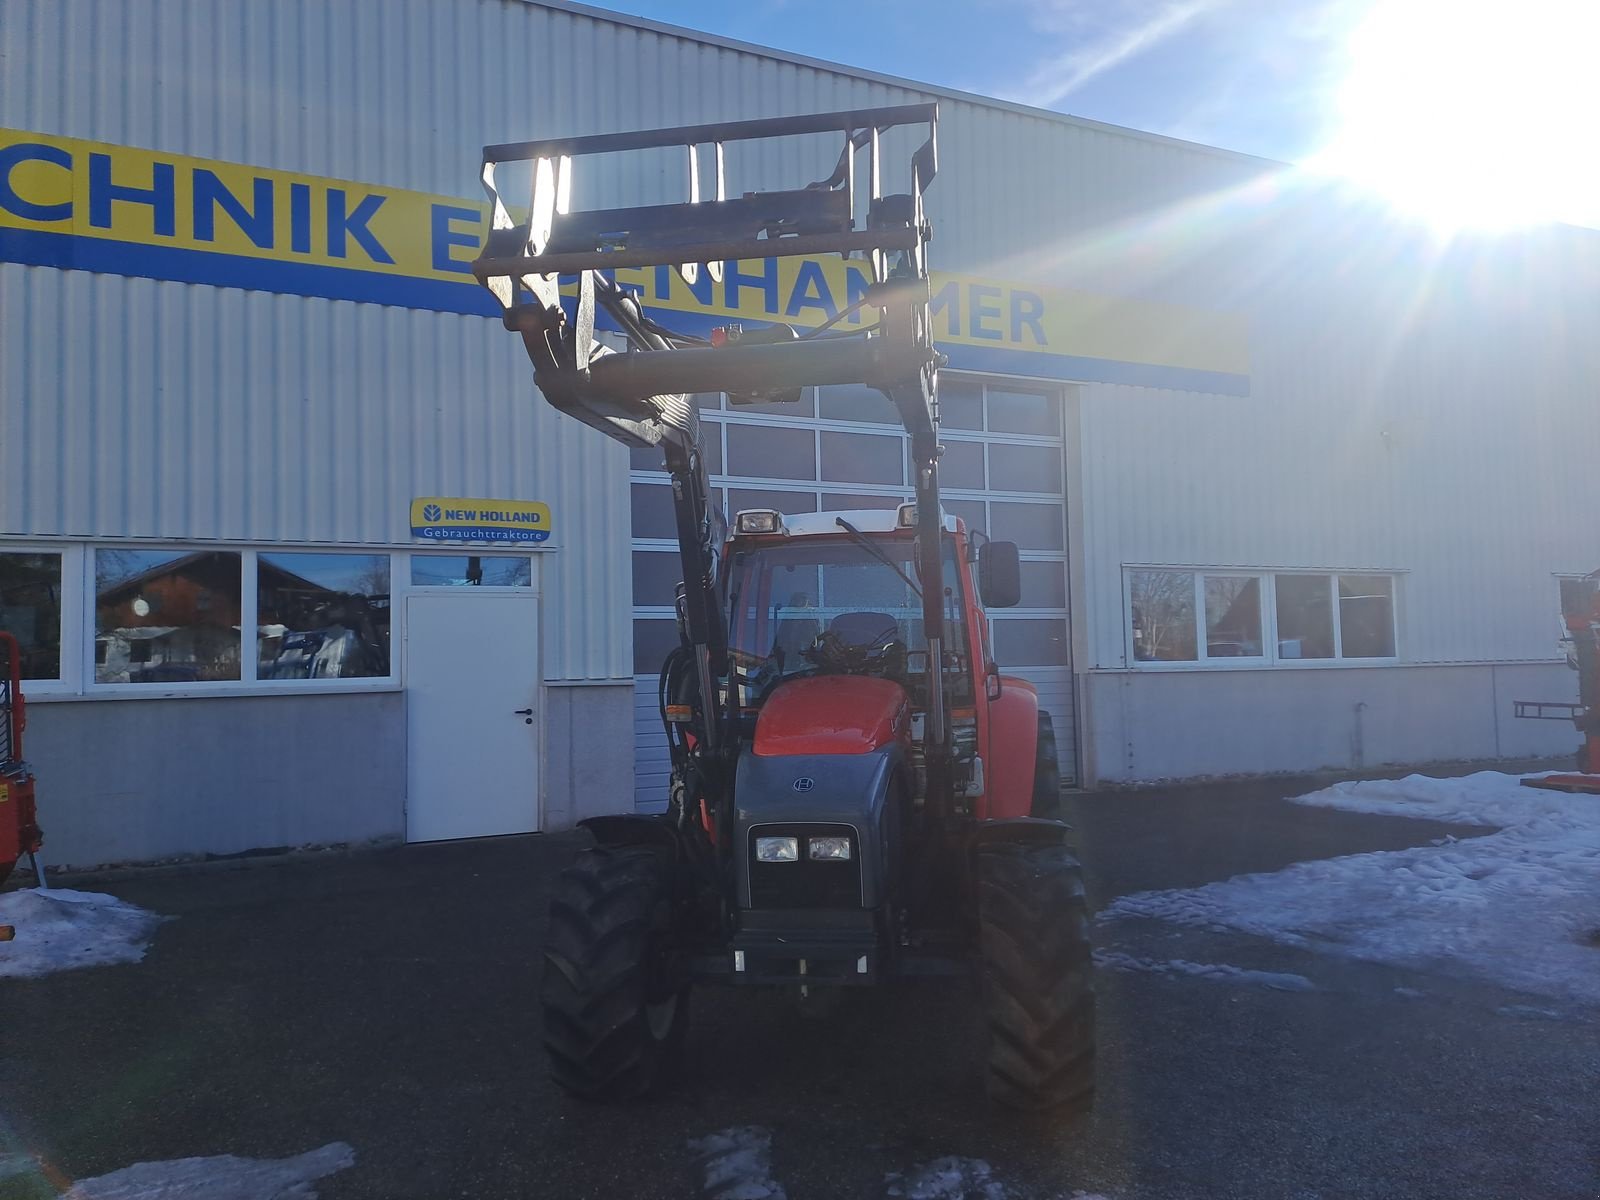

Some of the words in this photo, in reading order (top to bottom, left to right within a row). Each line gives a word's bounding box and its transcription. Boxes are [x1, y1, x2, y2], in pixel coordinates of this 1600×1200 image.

[445, 509, 476, 521] NEW
[480, 511, 541, 523] HOLLAND
[423, 527, 542, 540] Gebrauchttraktore
